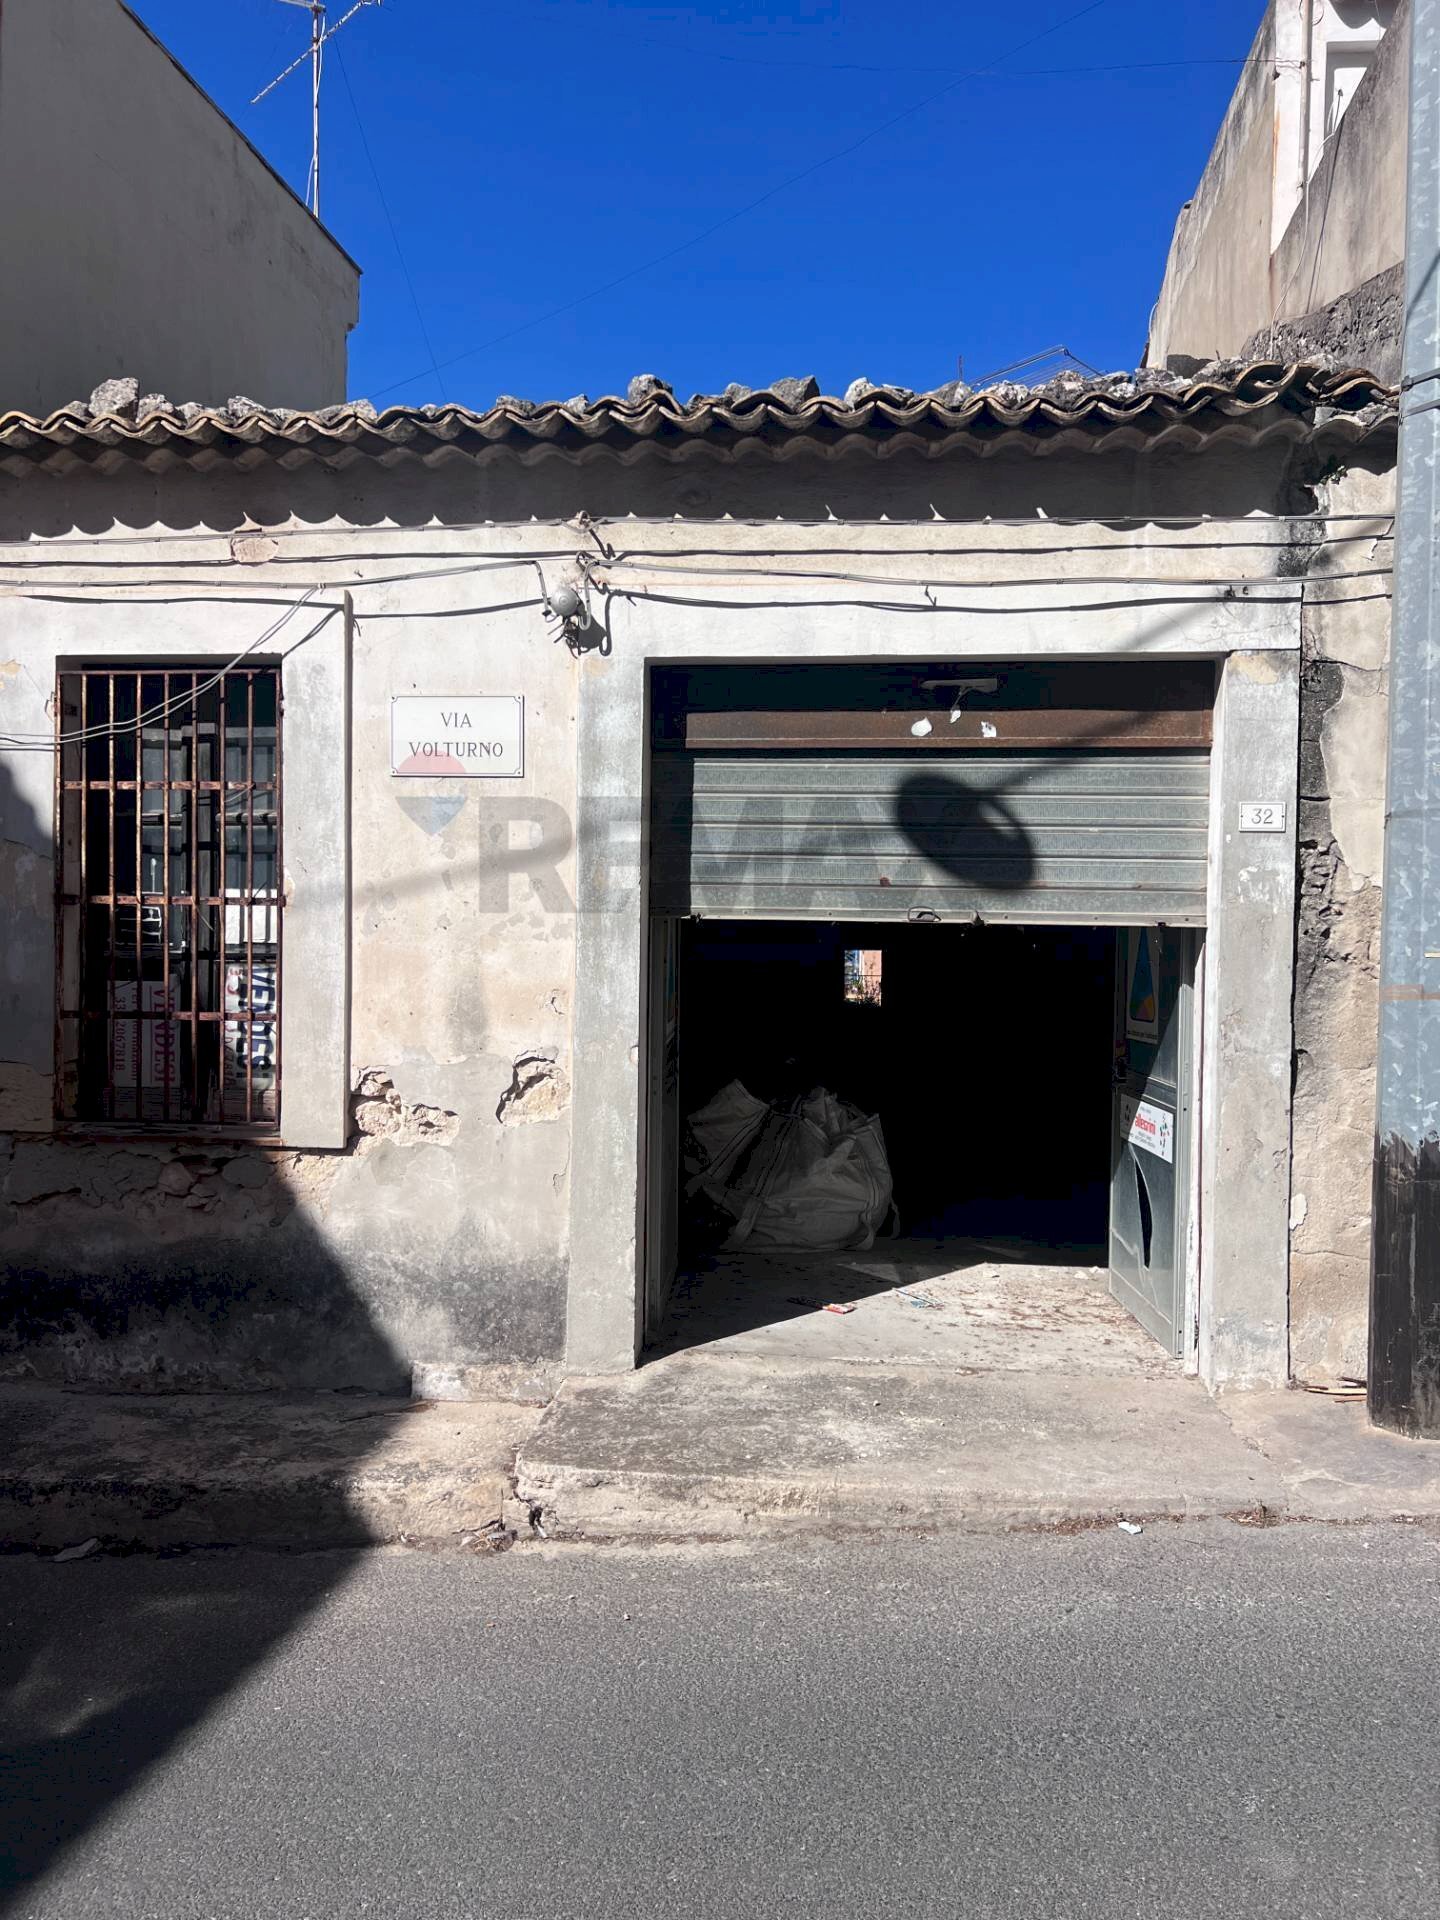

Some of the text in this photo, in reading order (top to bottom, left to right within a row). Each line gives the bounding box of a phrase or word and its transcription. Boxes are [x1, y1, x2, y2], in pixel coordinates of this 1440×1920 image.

[440, 712, 473, 728] VIA
[408, 742, 504, 758] VOLTURNO
[1251, 808, 1274, 825] 32
[236, 966, 275, 1079] VENDESI
[154, 985, 176, 1083] VENDESI
